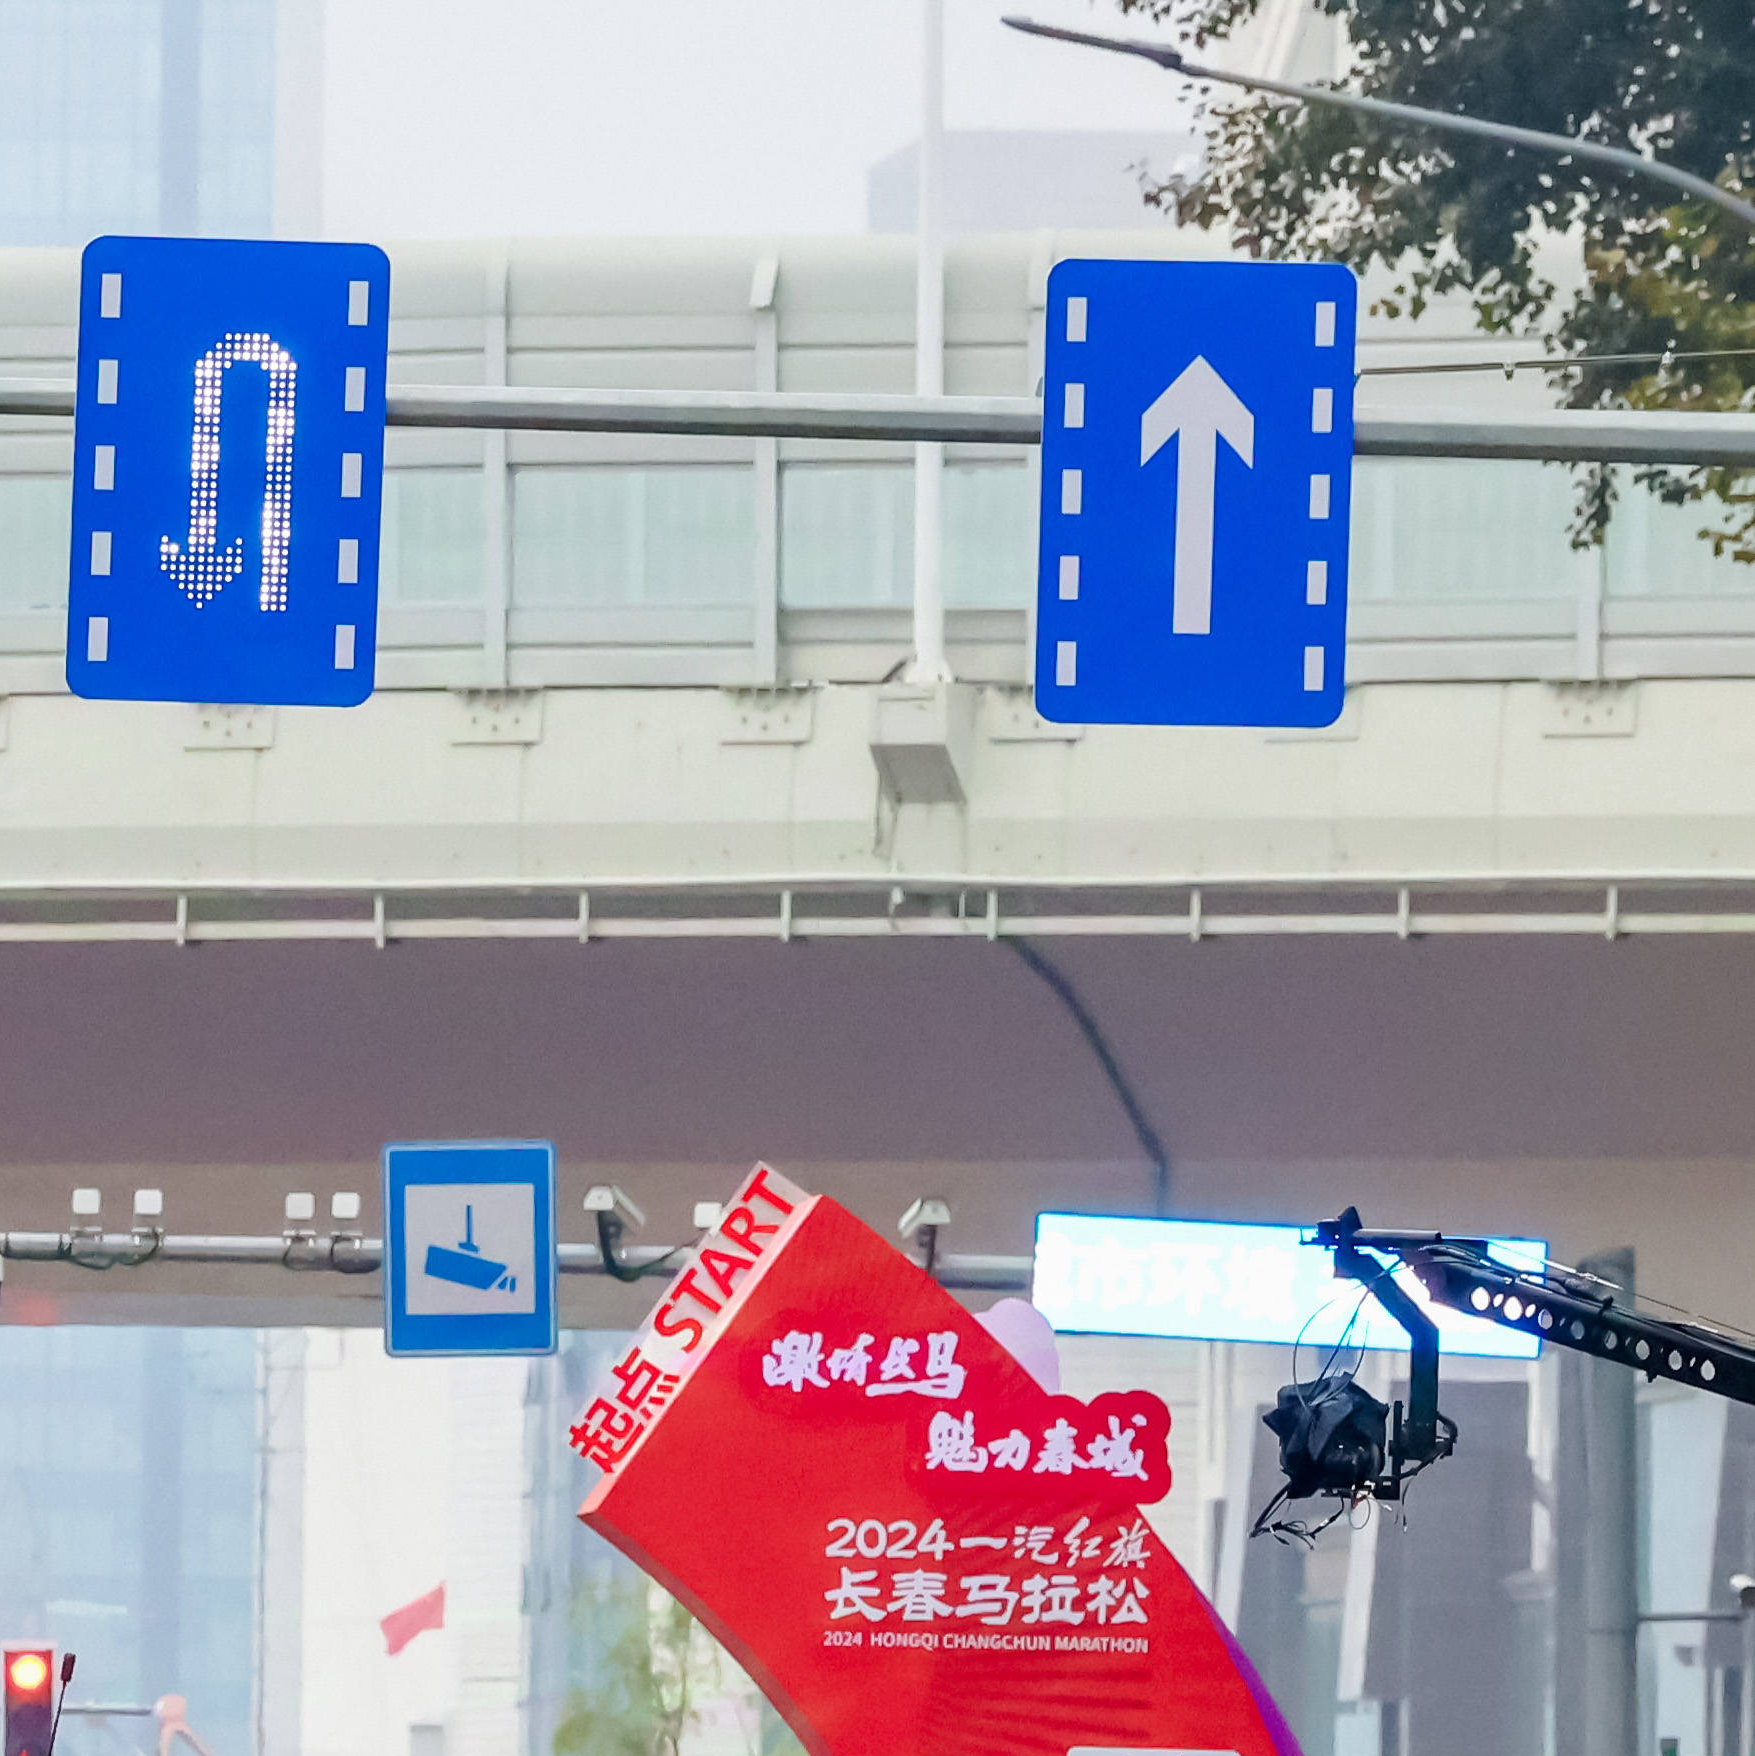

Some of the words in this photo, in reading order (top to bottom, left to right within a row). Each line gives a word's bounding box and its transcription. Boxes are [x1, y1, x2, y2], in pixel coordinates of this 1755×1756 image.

[654, 1170, 794, 1353] START
[569, 1346, 681, 1474] 起点
[925, 1410, 1150, 1481] 魅力春城
[824, 1516, 1151, 1569] 2024一汽红旗
[823, 1567, 1150, 1626] 长春马拉松
[823, 1630, 863, 1646] 2024
[869, 1631, 939, 1652] HONGQI
[942, 1632, 1051, 1651] CHANGCHUN
[1054, 1634, 1149, 1653] MARATHON
